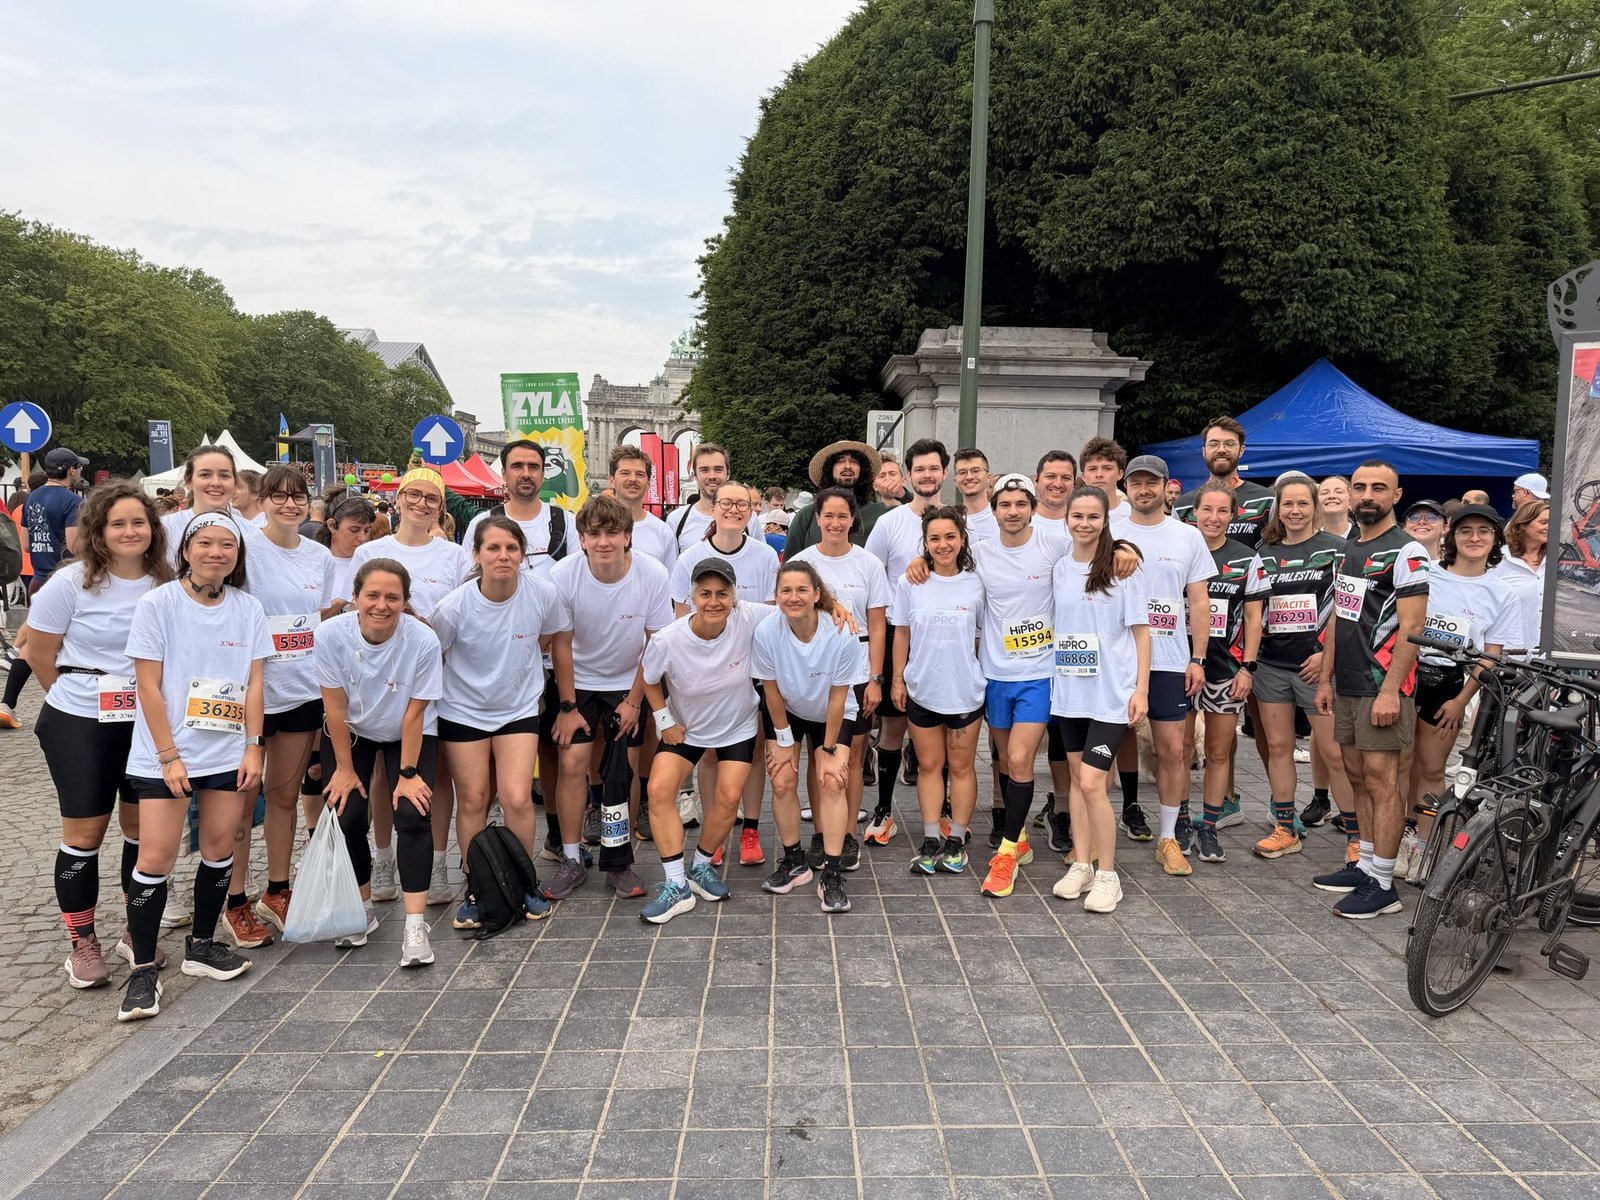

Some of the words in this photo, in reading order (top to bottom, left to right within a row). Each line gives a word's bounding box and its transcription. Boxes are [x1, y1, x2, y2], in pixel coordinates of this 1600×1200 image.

[511, 391, 575, 417] ZYLA
[1277, 569, 1324, 583] PALESTINE
[1207, 581, 1240, 595] ESTINE
[1148, 615, 1176, 628] 594
[1274, 611, 1313, 623] 26291
[1425, 616, 1458, 632] iPRO
[1010, 621, 1044, 635] HiPRO
[280, 634, 314, 649] 5547
[1013, 630, 1052, 648] 15594
[1059, 652, 1097, 666] 46868
[113, 693, 136, 708] 55
[200, 701, 244, 720] 36235
